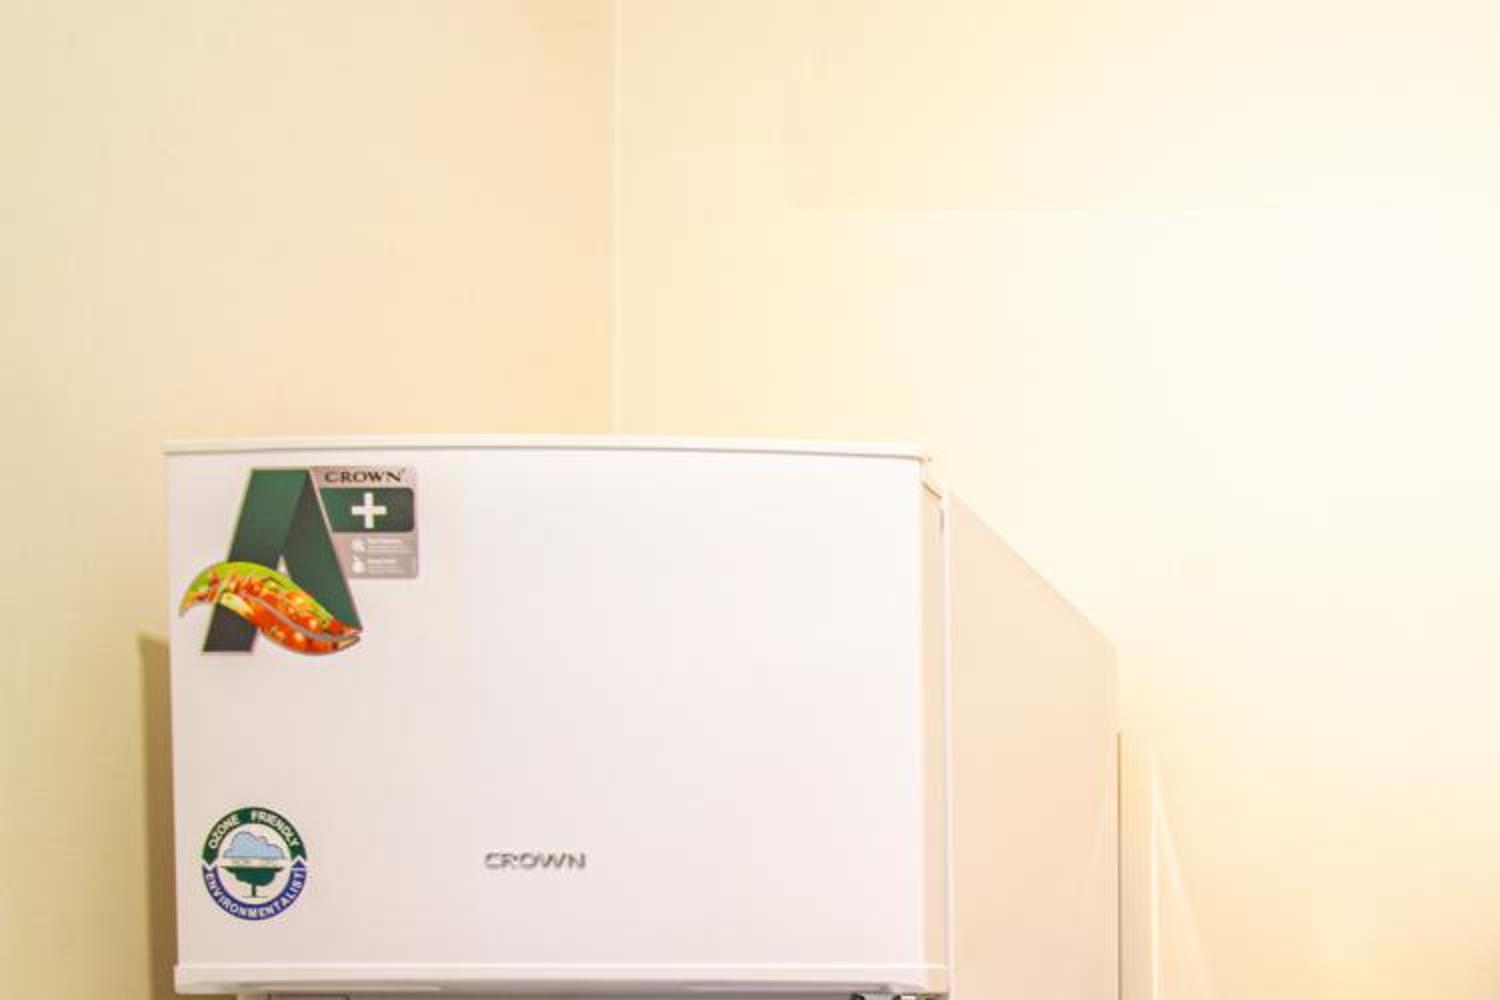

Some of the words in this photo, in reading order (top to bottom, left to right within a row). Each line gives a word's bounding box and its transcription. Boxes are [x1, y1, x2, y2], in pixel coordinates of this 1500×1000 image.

[324, 470, 402, 484] CROWN
[208, 813, 240, 850] OZONE
[250, 810, 300, 847] FRIENDLY
[484, 852, 586, 870] CROWN
